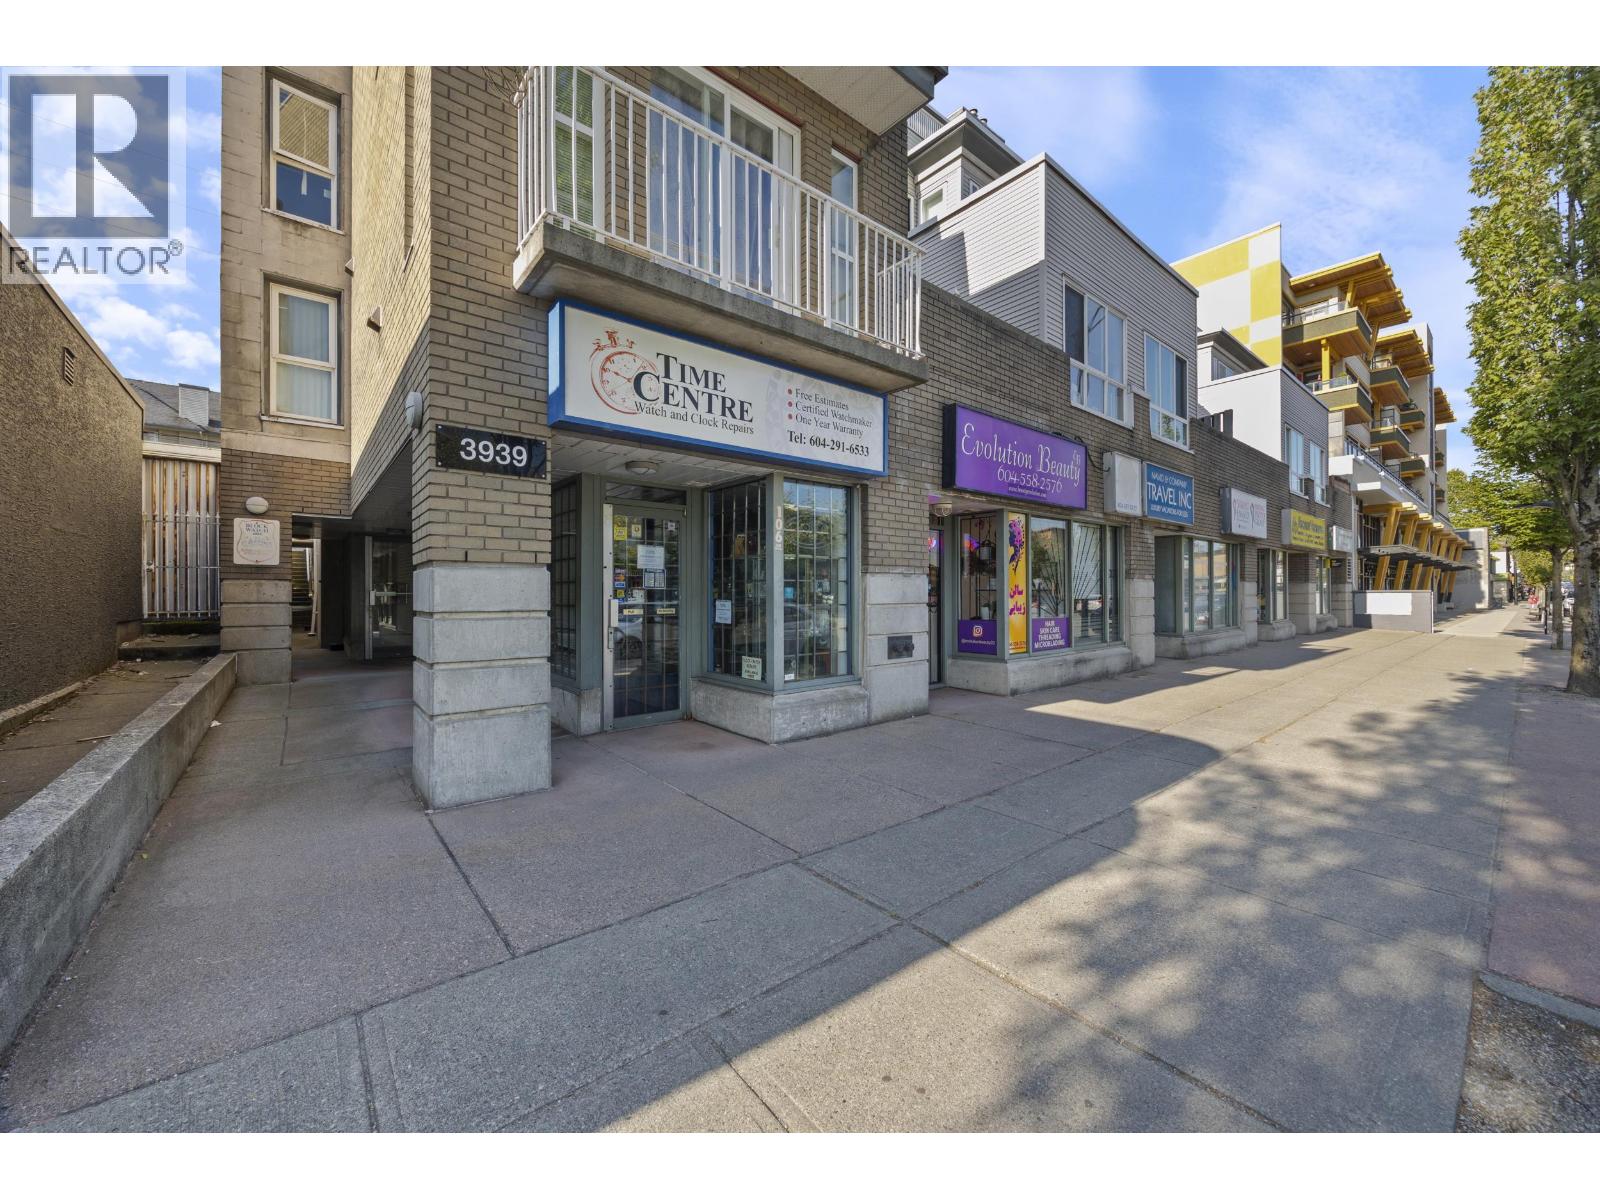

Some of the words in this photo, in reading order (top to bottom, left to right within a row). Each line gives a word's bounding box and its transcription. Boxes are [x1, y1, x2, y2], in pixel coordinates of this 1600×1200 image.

[656, 352, 727, 393] TIME
[633, 371, 753, 423] CENTRE
[795, 388, 813, 402] Free
[814, 393, 849, 411] Estimates
[634, 400, 667, 418] Watch
[670, 411, 688, 422] and
[690, 413, 719, 429] Clock
[721, 419, 754, 435] Repairs
[795, 400, 829, 418] Certified
[830, 409, 873, 428] Watchmaker
[795, 413, 812, 426] One
[813, 416, 831, 430] Year
[832, 421, 864, 440] Warranty
[460, 437, 528, 467] 3939
[787, 430, 806, 445] Tel:
[809, 435, 870, 457] 604-291-6533
[961, 422, 1033, 470] Evolution
[1037, 444, 1080, 488] Beauty
[1147, 482, 1176, 506] TRAVEL
[1178, 490, 1192, 510] INC
